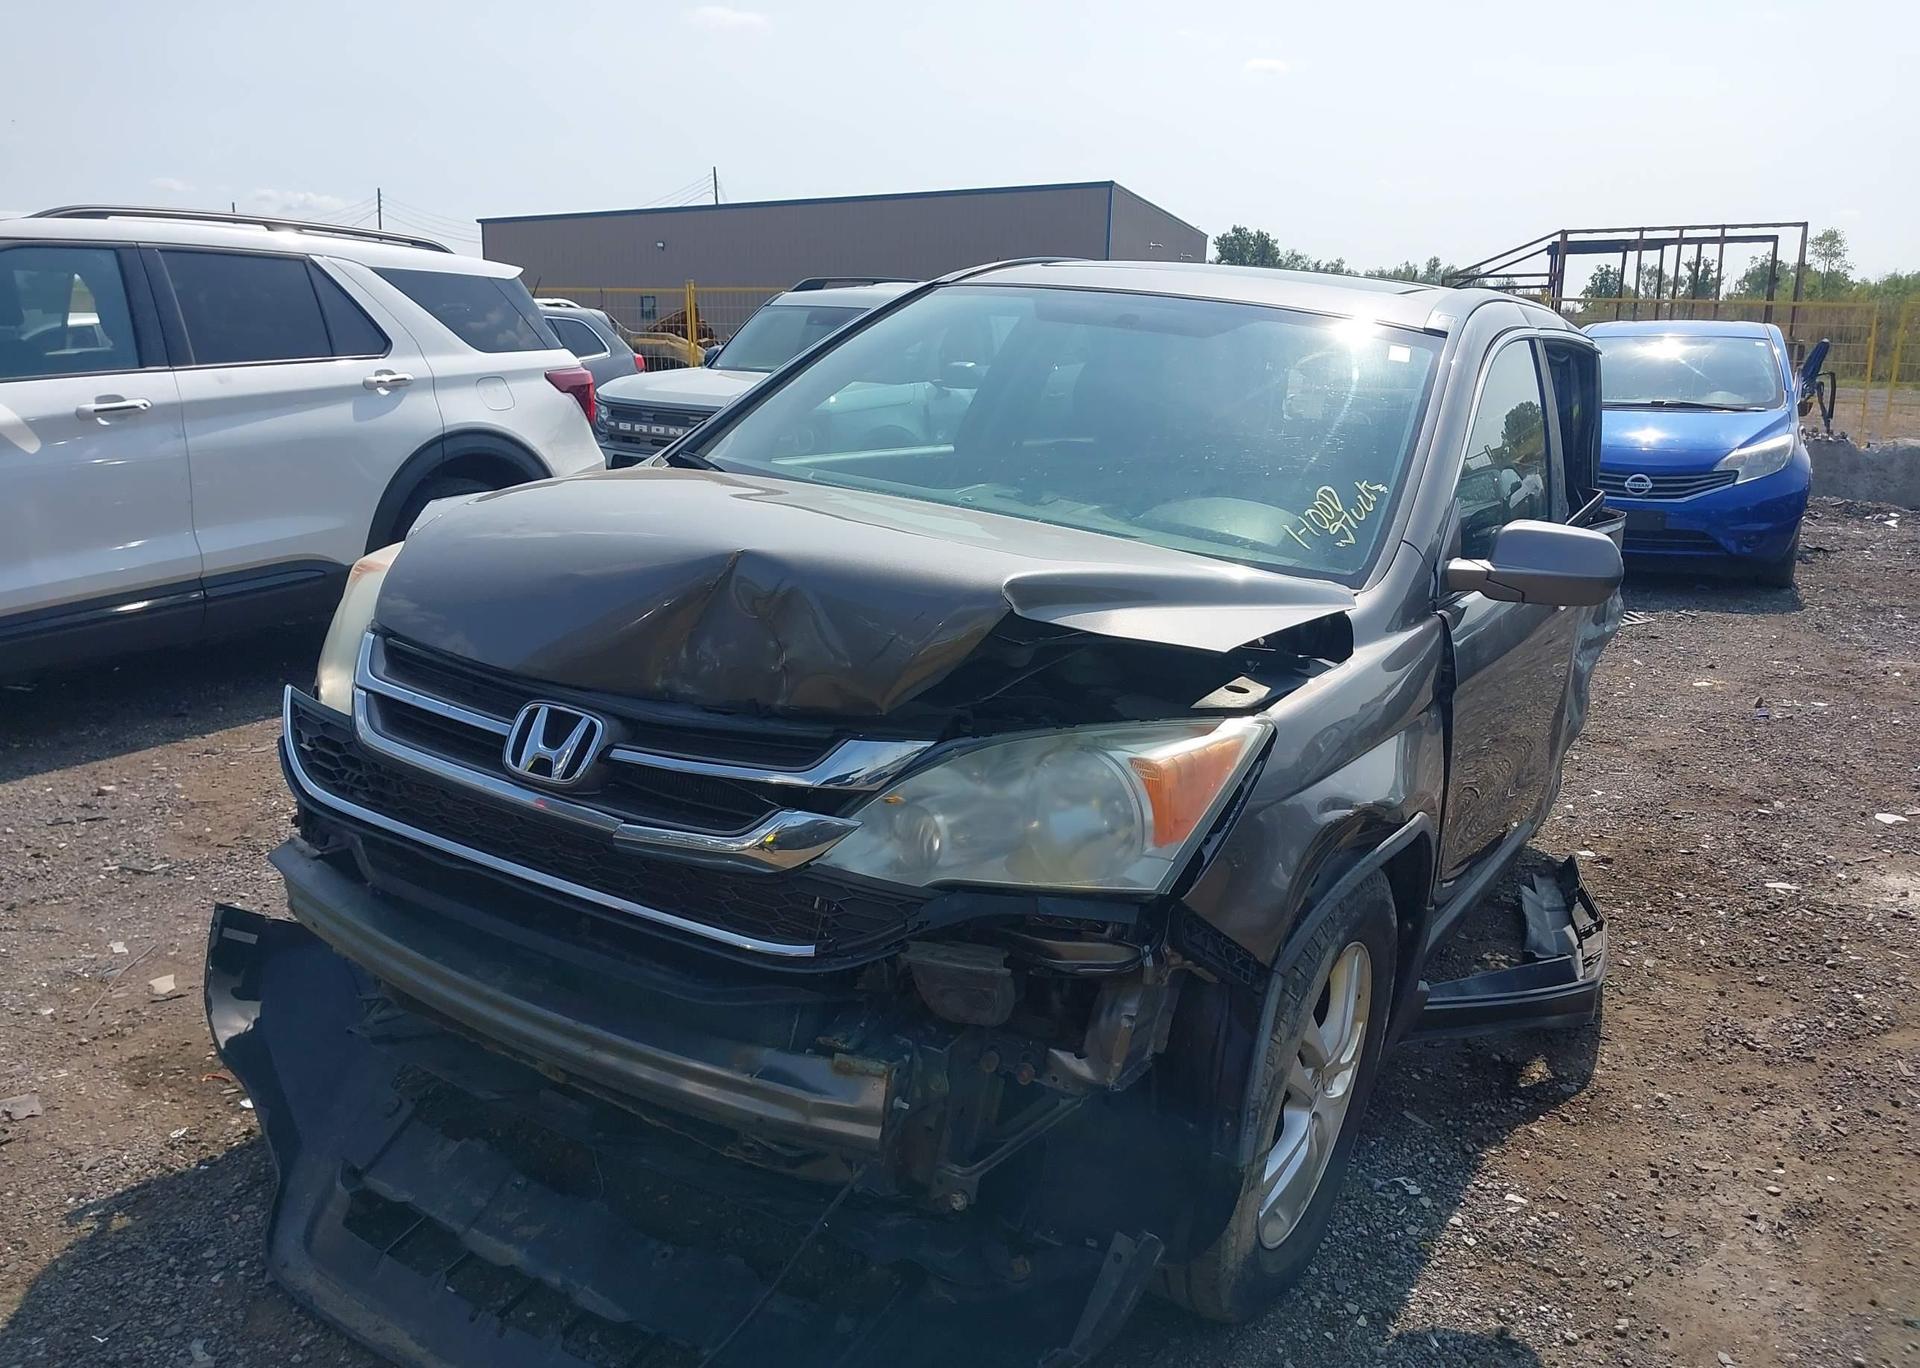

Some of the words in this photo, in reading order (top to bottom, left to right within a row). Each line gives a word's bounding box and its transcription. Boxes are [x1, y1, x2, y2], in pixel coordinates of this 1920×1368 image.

[619, 422, 684, 435] BRON
[1626, 481, 1651, 489] NISSAN
[1282, 486, 1342, 549] HOOD
